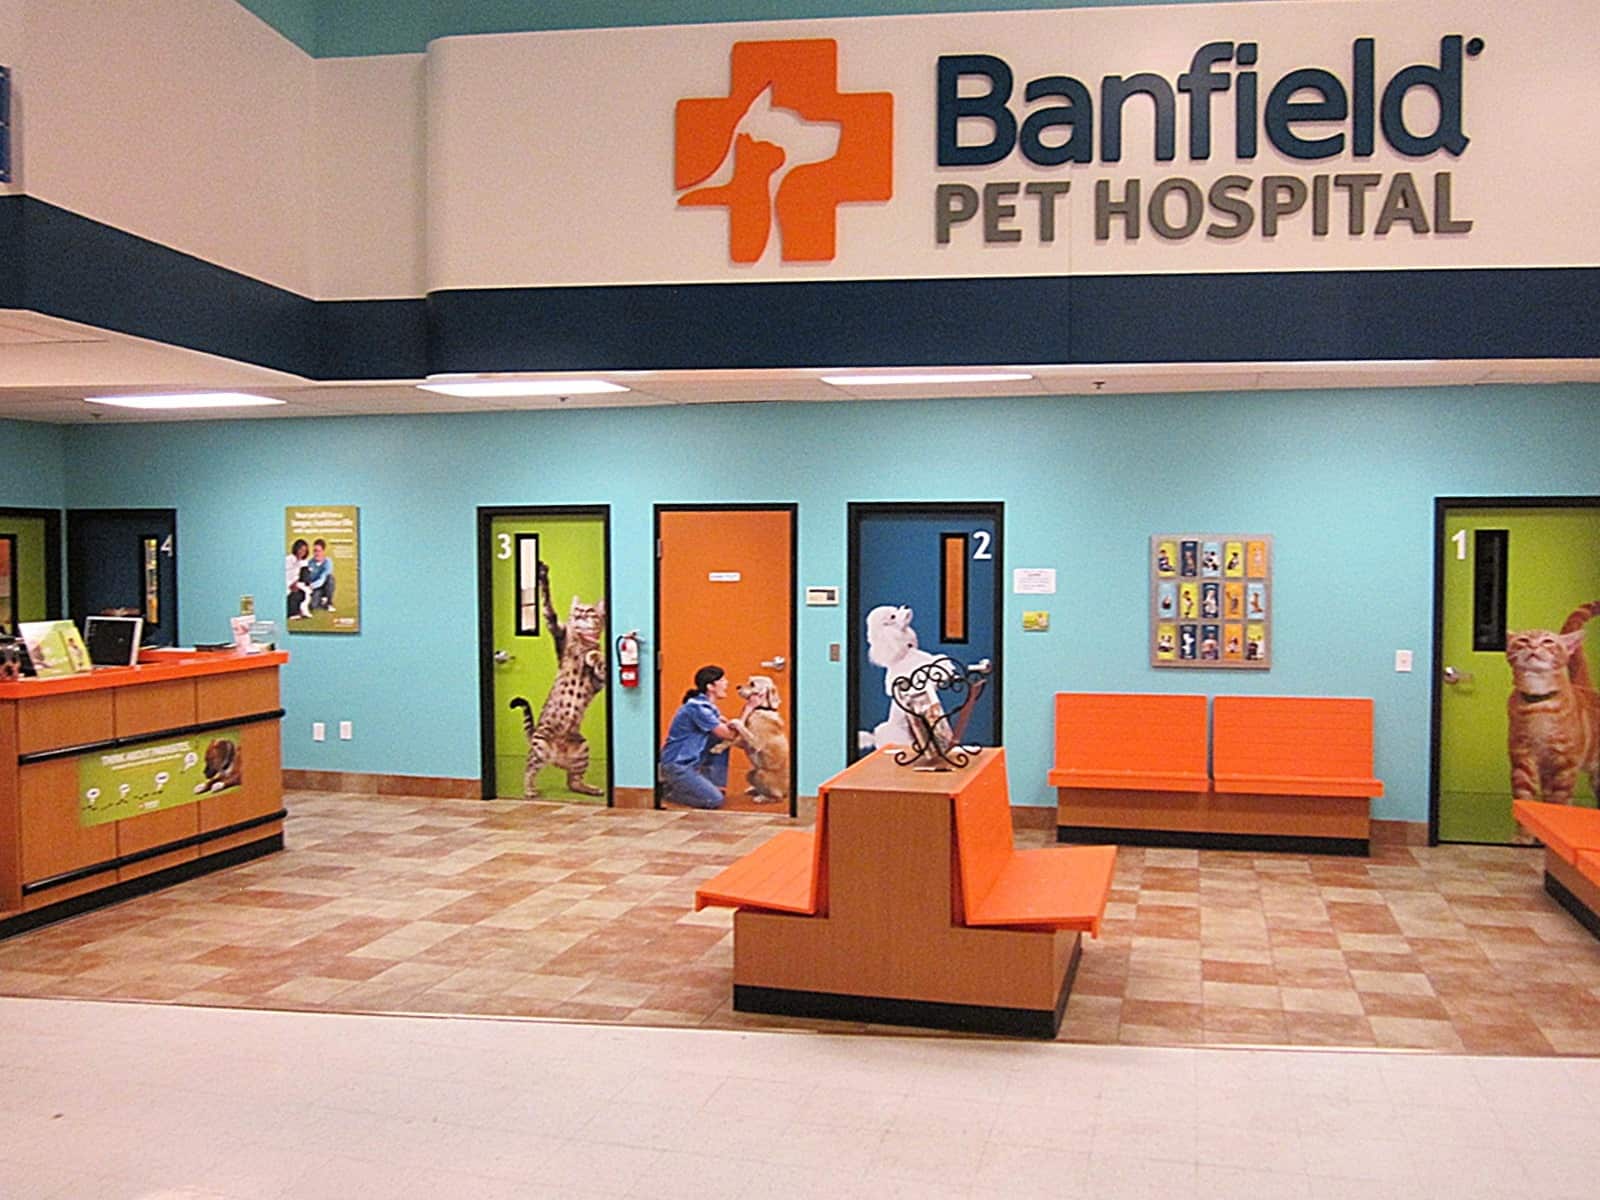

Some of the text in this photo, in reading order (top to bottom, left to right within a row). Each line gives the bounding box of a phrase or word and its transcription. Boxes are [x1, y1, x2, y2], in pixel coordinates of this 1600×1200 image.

[936, 34, 1471, 166] Banfield
[935, 172, 1473, 244] PET HOSPITAL
[160, 534, 174, 557] 4
[496, 533, 513, 560] 3
[972, 531, 993, 560] 2
[1451, 529, 1467, 560] 1
